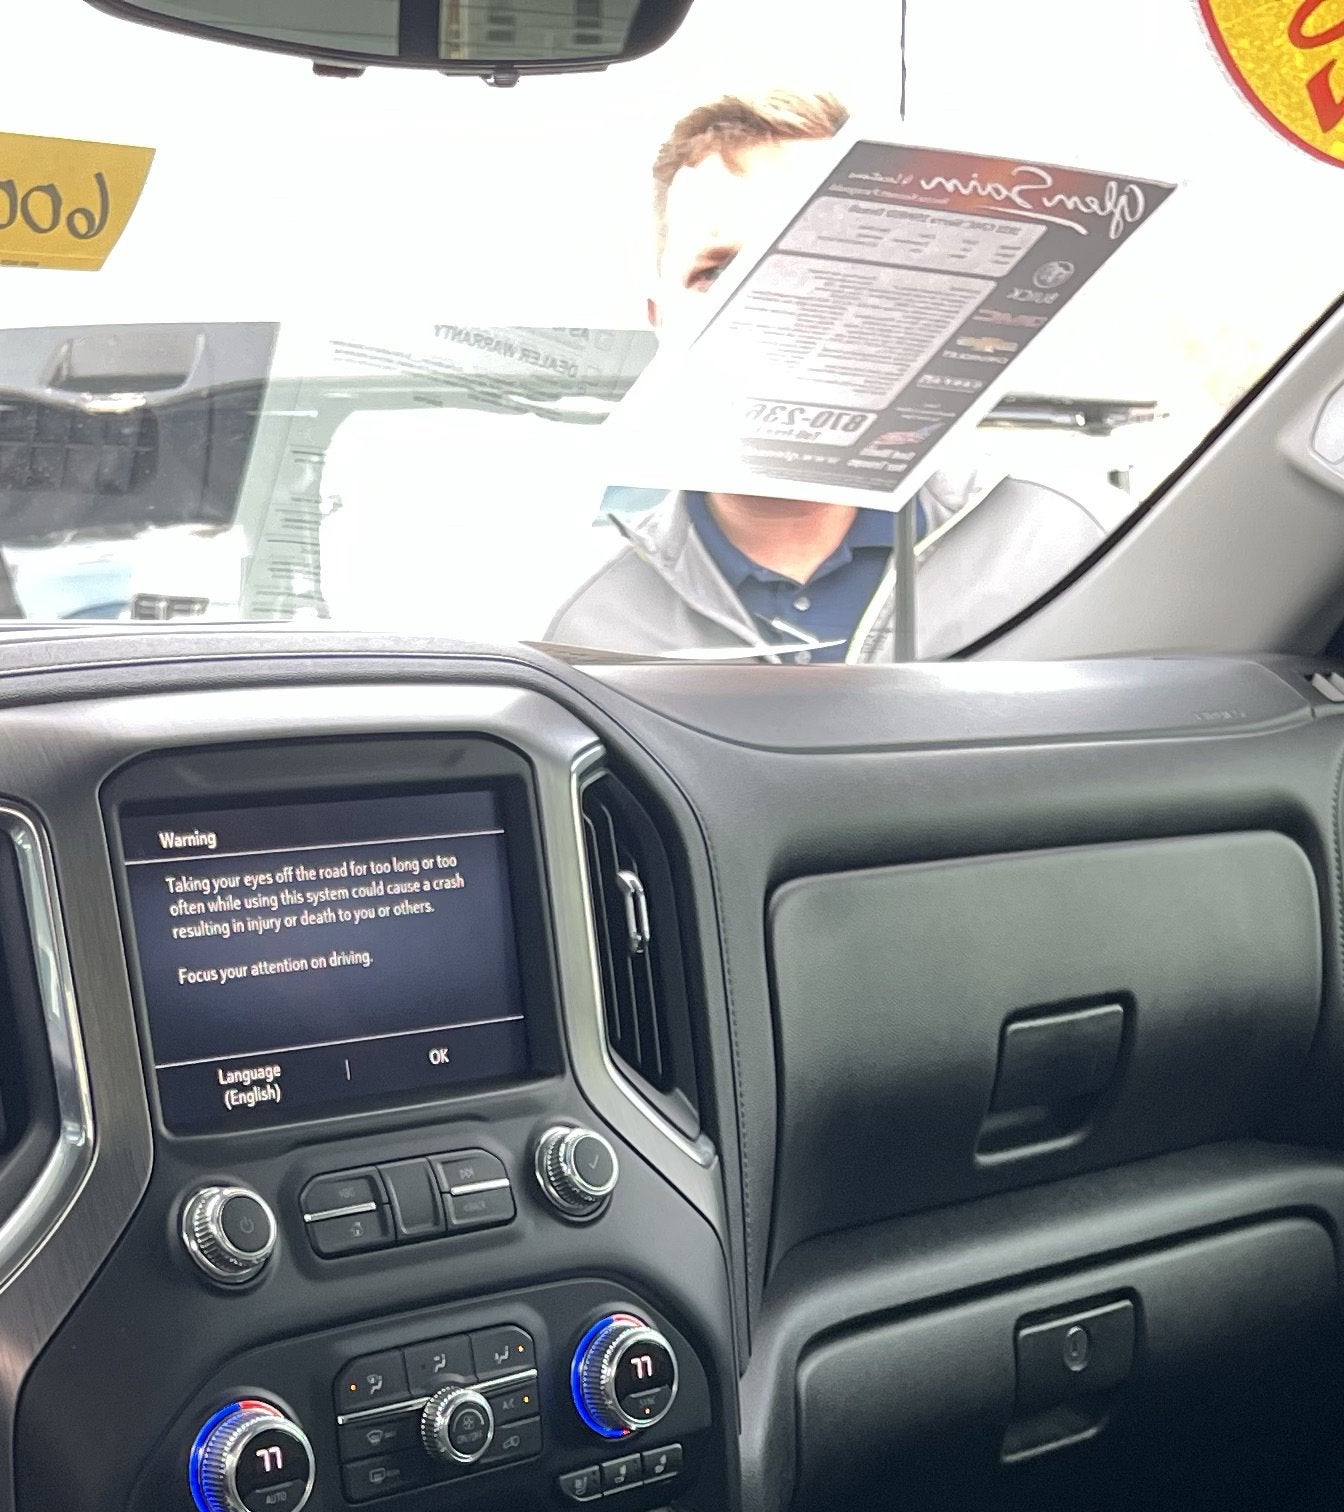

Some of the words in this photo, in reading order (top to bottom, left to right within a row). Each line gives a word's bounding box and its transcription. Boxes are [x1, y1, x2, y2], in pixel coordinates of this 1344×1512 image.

[158, 830, 217, 850] Warning
[166, 876, 210, 895] Taking
[211, 874, 241, 891] your
[244, 872, 273, 889] eyes
[276, 867, 294, 884] off
[295, 866, 317, 882] the
[318, 862, 347, 879] road
[349, 861, 368, 877] for
[369, 859, 391, 875] too
[392, 857, 420, 875] long
[421, 858, 435, 870] or
[436, 854, 457, 868] too
[169, 899, 205, 917] often
[207, 895, 242, 913] while
[243, 893, 279, 912] using
[280, 889, 304, 906] this
[306, 886, 349, 907] system
[351, 883, 385, 899] could
[386, 880, 421, 896] cause
[423, 881, 430, 892] a
[432, 874, 465, 891] crash
[172, 919, 231, 940] resulting
[232, 918, 245, 933] in
[246, 913, 282, 933] injury
[283, 914, 298, 927] or
[299, 908, 337, 926] death
[337, 907, 352, 921] to
[353, 906, 376, 924] you
[377, 906, 392, 918] or
[393, 900, 435, 917] others.
[178, 967, 218, 986] Focus
[219, 965, 248, 982] your
[250, 957, 308, 977] attention
[310, 955, 327, 969] on
[329, 949, 374, 968] driving.
[429, 1048, 450, 1065] OK
[218, 1063, 281, 1085] Language
[224, 1084, 282, 1110] (English)
[630, 1355, 653, 1379] 77
[256, 1446, 283, 1472] 77
